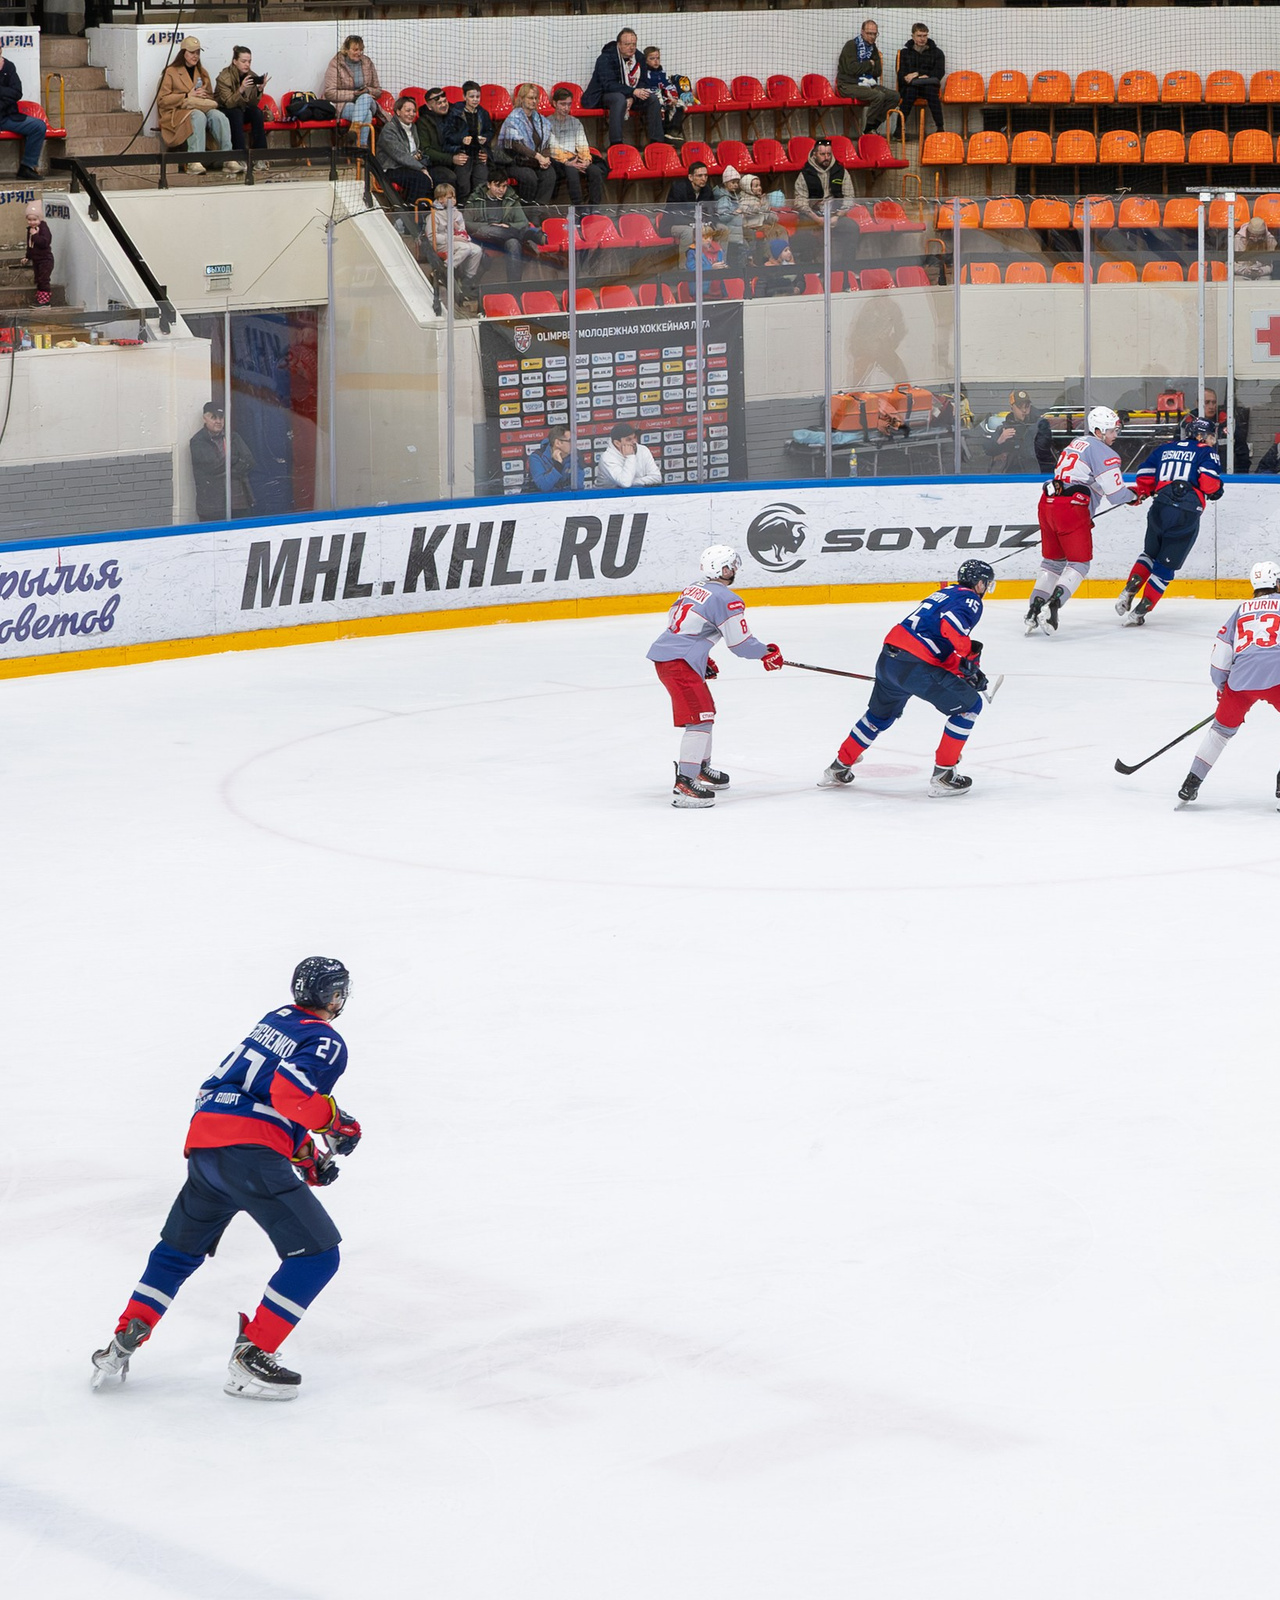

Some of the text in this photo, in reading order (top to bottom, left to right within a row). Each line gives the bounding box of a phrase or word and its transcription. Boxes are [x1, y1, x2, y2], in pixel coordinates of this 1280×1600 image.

[205, 265, 232, 274] ВЫХОД
[537, 320, 711, 342] OLIMPBE МОЛОДЕЖНАЯ ХОККЕЙНАЯ ЛГА
[1159, 461, 1192, 482] 44
[821, 524, 1041, 553] SOYUZ
[240, 512, 649, 611] MHL.KHL.RU
[0, 559, 122, 601] рылья
[965, 598, 980, 614] 45
[1242, 600, 1279, 613] TYURIN
[0, 594, 121, 644] оветов
[315, 1037, 342, 1066] 27
